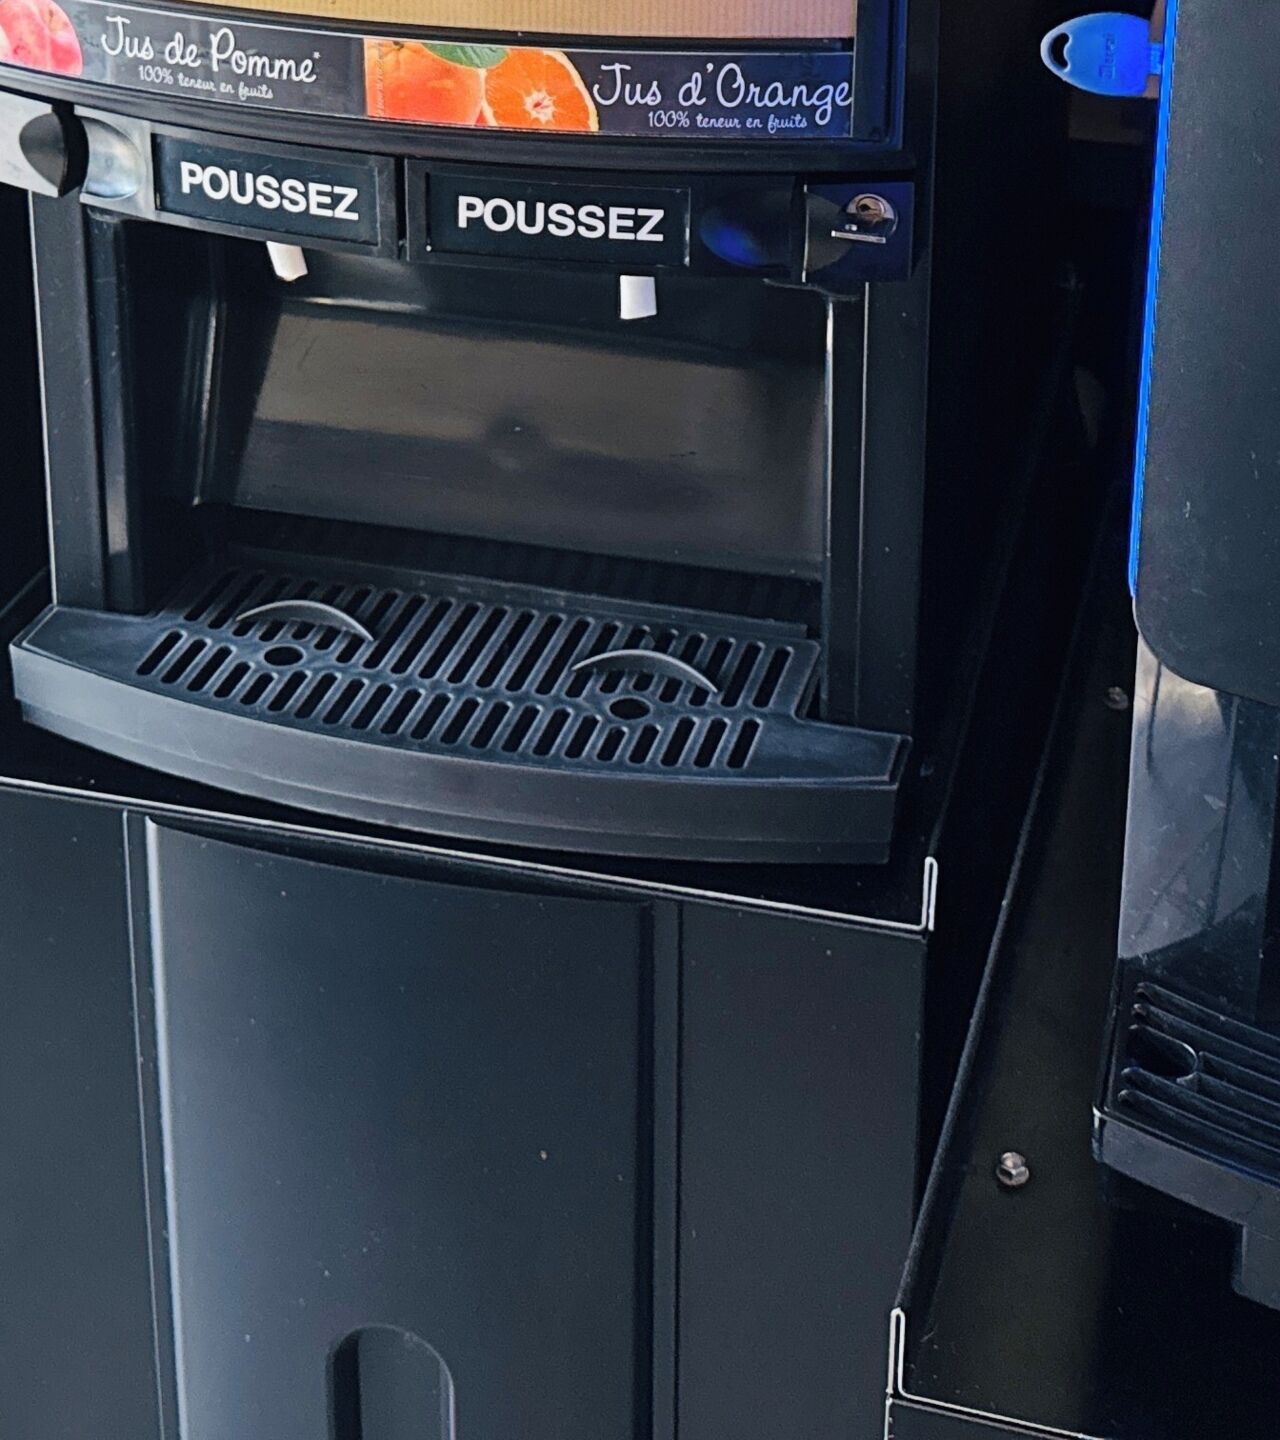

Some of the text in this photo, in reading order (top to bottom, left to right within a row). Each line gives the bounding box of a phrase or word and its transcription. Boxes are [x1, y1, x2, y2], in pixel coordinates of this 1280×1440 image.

[101, 15, 155, 61] Jus
[164, 32, 202, 68] de
[138, 64, 274, 101] 100% teneur en fruits
[592, 62, 853, 126] Jus d'Orange
[648, 110, 808, 134] 100% teneur en fruits
[180, 161, 360, 221] POUSSEZ
[457, 194, 665, 242] POUSSEZ
